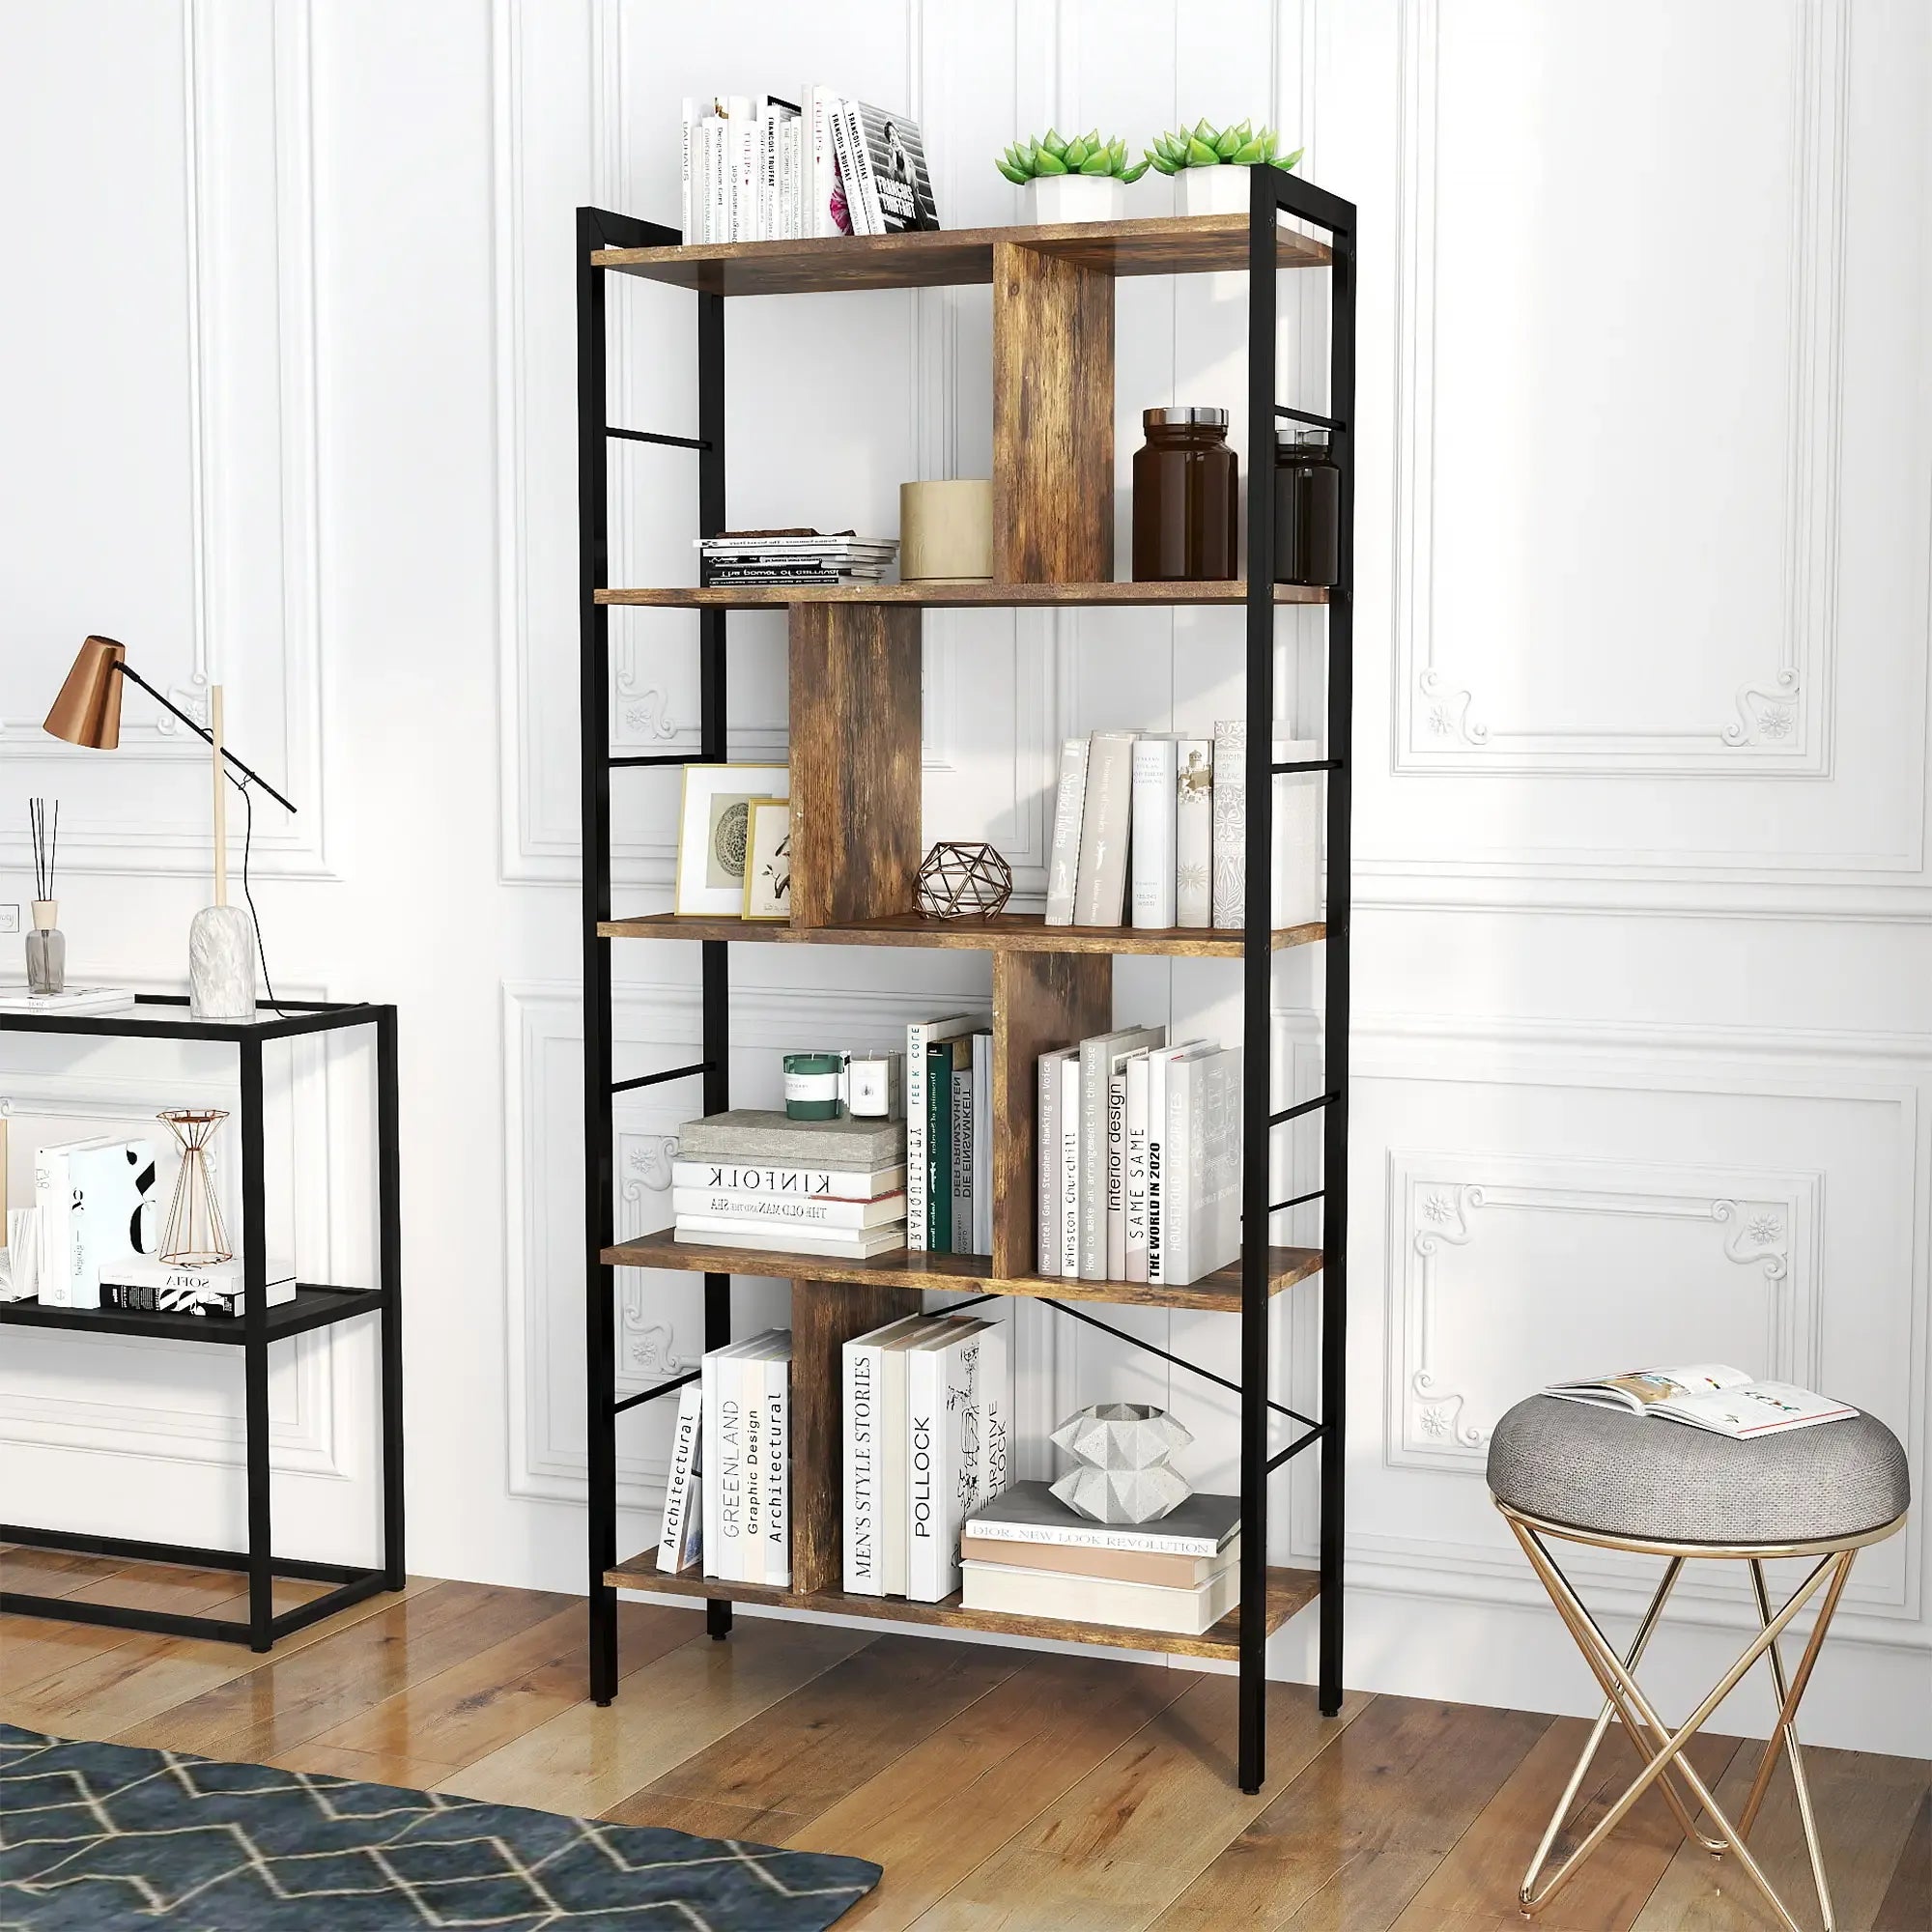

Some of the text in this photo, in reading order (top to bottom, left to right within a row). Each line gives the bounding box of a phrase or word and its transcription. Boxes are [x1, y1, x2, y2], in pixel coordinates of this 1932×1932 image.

[1056, 773, 1078, 849] Sherlock Holmes
[1042, 1062, 1051, 1090] Voice
[1042, 1105, 1053, 1146] Hawking
[1042, 1150, 1053, 1188] Stephen
[1042, 1194, 1051, 1216] Gave
[1065, 1133, 1075, 1267] Winston Churchill
[1086, 1046, 1097, 1271] How to make an arrangement in the house
[1108, 1083, 1124, 1211] Interior design
[1129, 1128, 1145, 1239] SAME SAME
[1042, 1221, 1051, 1249] Intel
[1042, 1254, 1051, 1271] How
[1150, 1143, 1161, 1278] THE WORLD IN 2020
[664, 1415, 694, 1548] Architectural
[723, 1401, 740, 1538] GREENLAND
[747, 1410, 761, 1535] Graphic Design
[768, 1392, 782, 1544] Architectural
[854, 1357, 871, 1578] MEN'S STYLE STORIES
[914, 1416, 931, 1538] POLLOCK
[988, 1401, 997, 1501] URATIVE
[1018, 1529, 1053, 1542] NEW
[1059, 1532, 1101, 1546] LOOK
[1107, 1536, 1208, 1554] REVOLUTION
